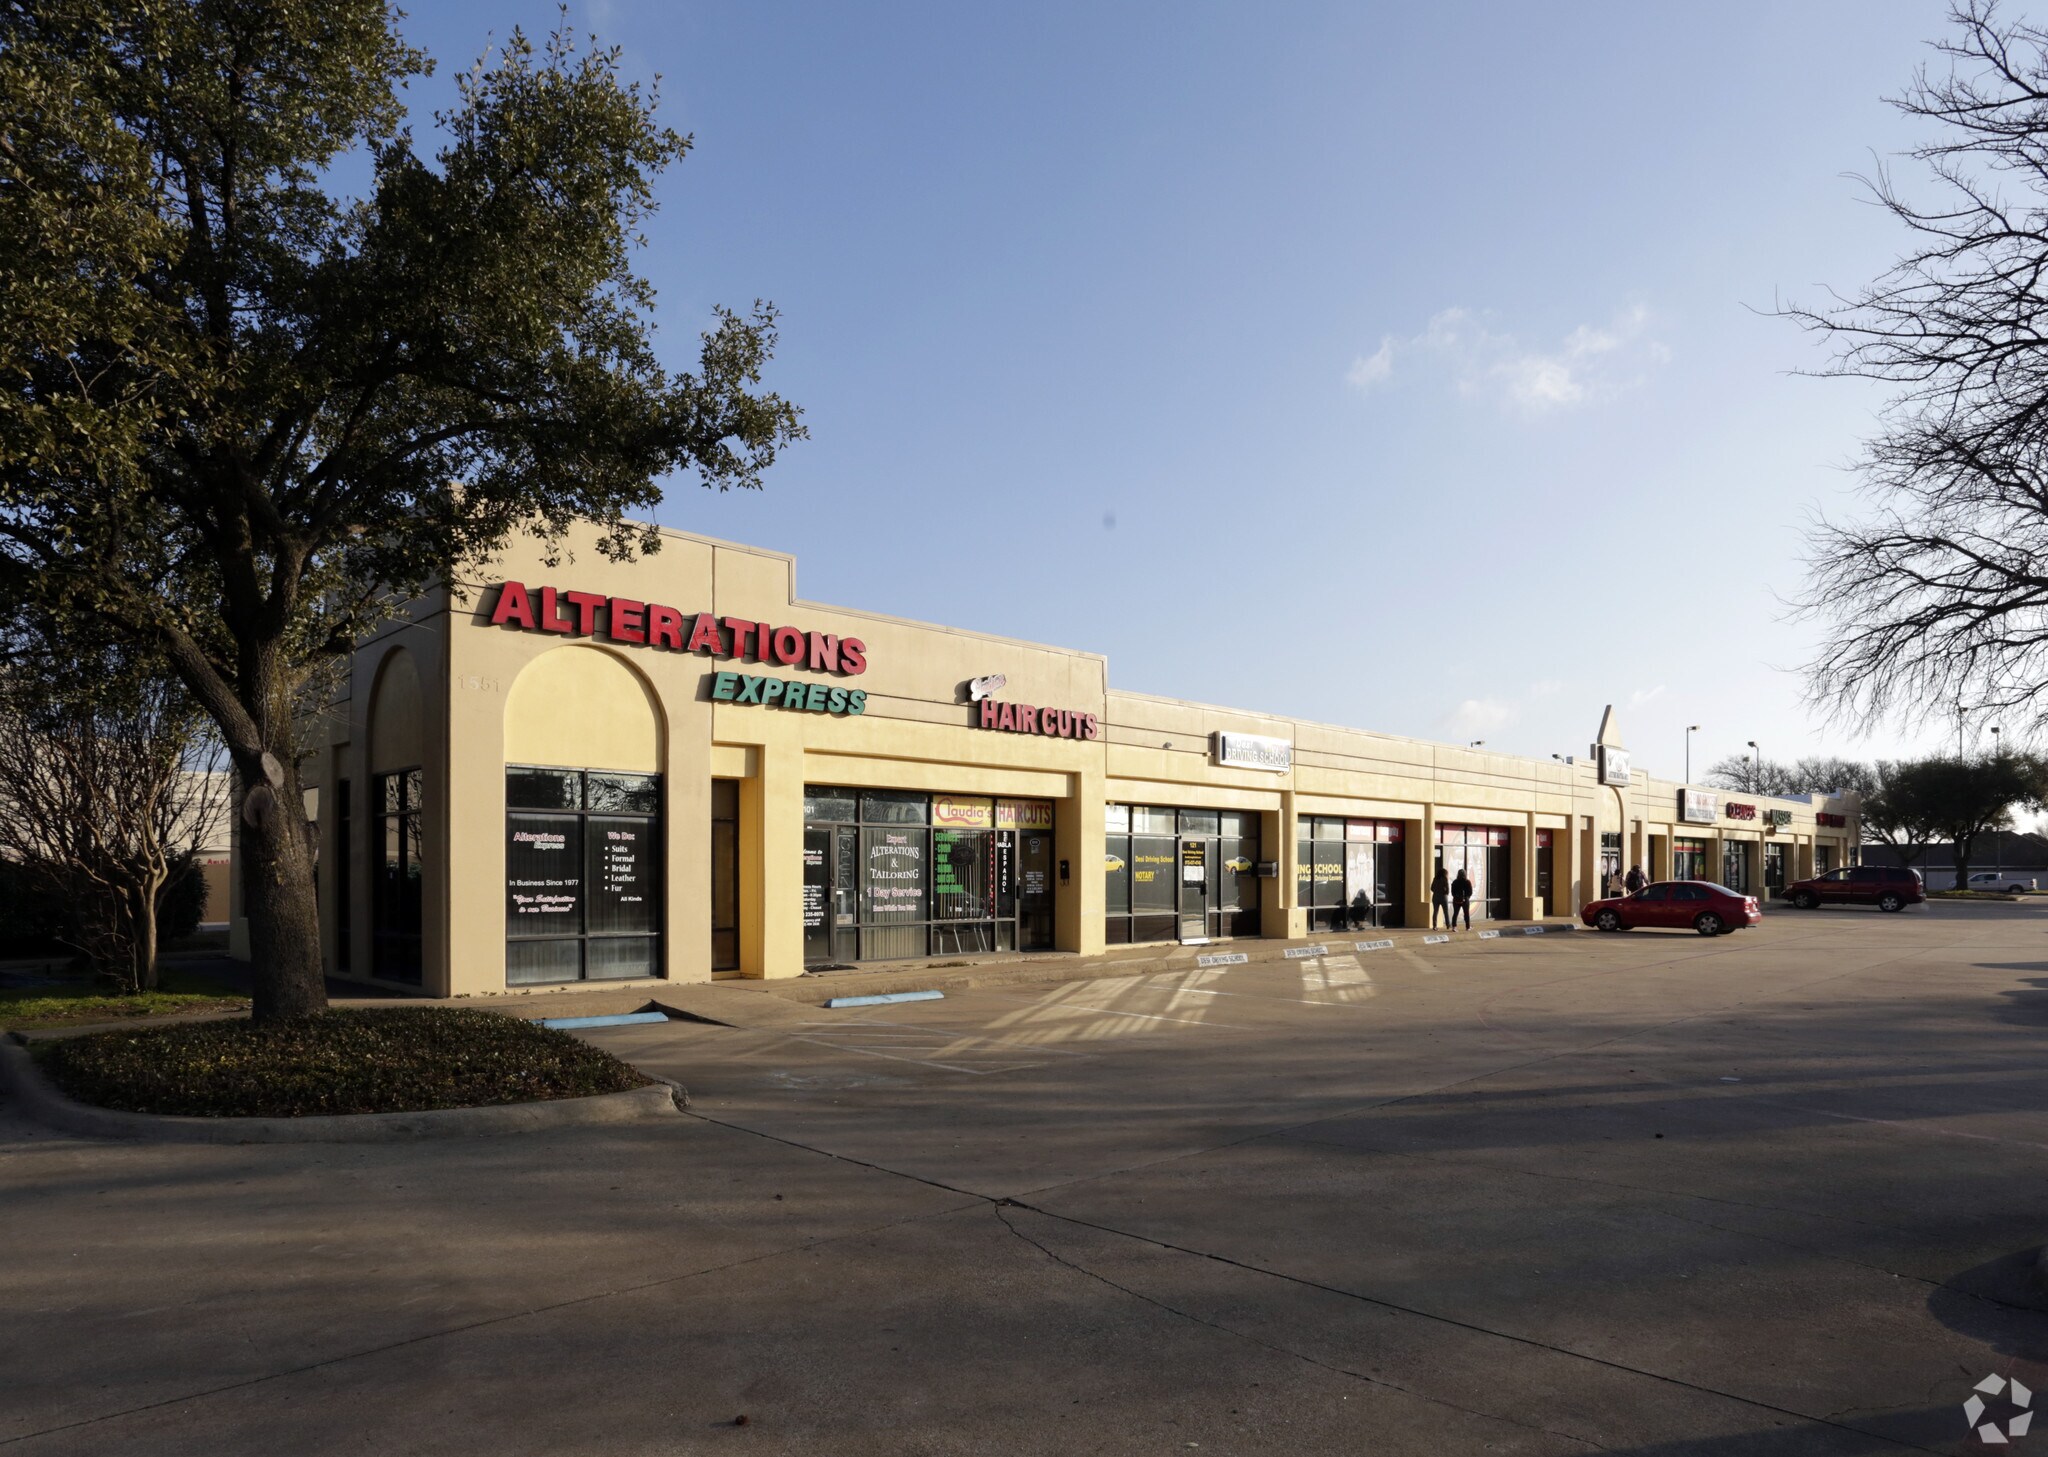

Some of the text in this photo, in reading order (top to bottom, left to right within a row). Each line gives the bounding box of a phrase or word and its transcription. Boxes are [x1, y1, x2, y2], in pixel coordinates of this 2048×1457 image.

[491, 581, 867, 676] ALTERATIONS
[457, 672, 499, 694] 1551
[711, 671, 868, 716] EXPRESS
[981, 698, 1098, 740] HAIR CUTS
[1226, 748, 1258, 762] DRIVING
[1259, 752, 1288, 766] SCHOOL
[935, 798, 993, 821] Claudia's
[999, 803, 1051, 824] HAIRCUTS
[513, 831, 566, 842] Alterations
[611, 845, 628, 853] Suits
[870, 846, 920, 859] ALTERATIONS
[611, 854, 635, 862] Formal
[890, 858, 899, 868] &
[611, 864, 631, 872] Bridal
[870, 868, 920, 879] TAILORING
[1314, 863, 1343, 874] SCHOOL
[611, 874, 636, 882] Leather
[1135, 871, 1155, 880] NOTARY
[611, 884, 623, 892] Fur
[873, 887, 890, 899] Day
[891, 886, 922, 897] Service
